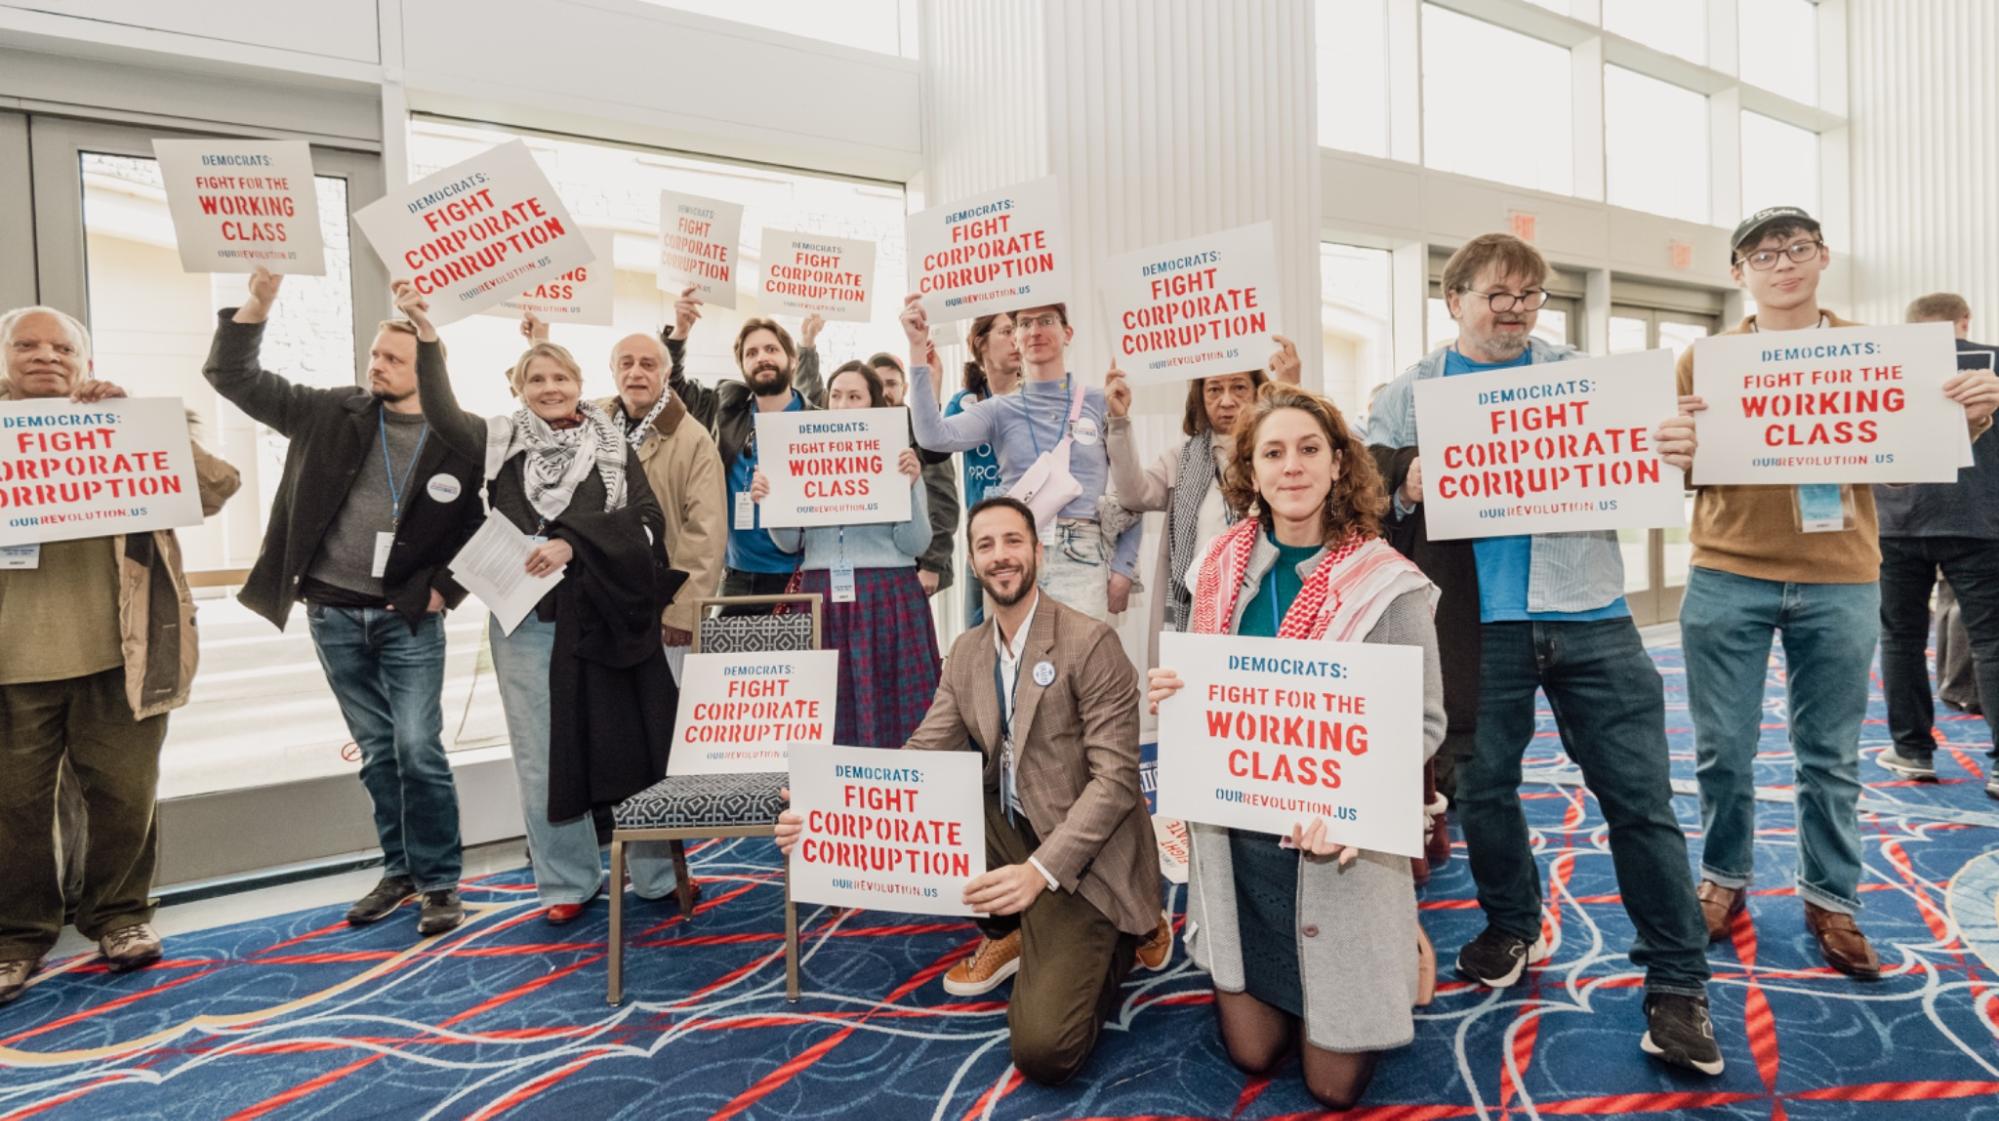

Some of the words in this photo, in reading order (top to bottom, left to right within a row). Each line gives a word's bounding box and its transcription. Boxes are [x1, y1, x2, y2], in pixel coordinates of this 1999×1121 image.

[195, 176, 235, 189] FIGHT
[239, 177, 263, 189] FOR
[265, 177, 289, 190] THE
[408, 172, 490, 213] DEMOCRATS:
[199, 196, 295, 217] WORKING
[423, 188, 496, 232] FIGHT
[945, 199, 1014, 224] DEMOCRATS:
[221, 221, 287, 242] CLASS
[405, 197, 546, 270] CORPORATE
[678, 217, 711, 238] FIGHT
[952, 215, 1010, 243] FIGHT
[414, 217, 566, 295] CORRUPTION
[664, 234, 728, 262] CORPORATE
[795, 252, 841, 269] FIGHT
[924, 230, 1046, 271] CORPORATE
[662, 251, 729, 282] CORRUPTION
[771, 265, 863, 287] CORPORATE
[920, 253, 1054, 294] CORRUPTION
[1142, 250, 1222, 276] DEMOCRATS:
[765, 280, 865, 302] CORRUPTION
[945, 285, 1031, 307] OURREVOLUTION.US
[1151, 268, 1217, 300] FIGHT
[1122, 287, 1257, 330] CORPORATE
[1122, 312, 1266, 355] CORRUPTION
[1762, 342, 1881, 363] DEMOCRATS:
[1743, 371, 1804, 389] FIGHT
[1811, 369, 1853, 385] FOR
[1861, 365, 1904, 382] THE
[1478, 379, 1596, 405] DEMOCRATS:
[1741, 387, 1905, 418] WORKING
[3, 413, 122, 428] DEMOCRATS:
[799, 422, 868, 434] DEMOCRATS:
[1490, 400, 1589, 435] FIGHT
[17, 428, 116, 453] FIGHT
[1764, 420, 1878, 447] CLASS
[788, 442, 825, 455] FIGHT
[828, 441, 853, 453] FOR
[856, 439, 880, 451] THE
[1444, 427, 1648, 469] CORPORATE
[0, 451, 169, 481] ORPORATE
[788, 455, 883, 476] WORKING
[1752, 453, 1894, 468] OURREVOLUTIONUS
[0, 475, 182, 508] ORRUPTION
[804, 479, 869, 498] CLASS
[1439, 459, 1660, 499] CORRUPTION
[10, 508, 148, 527] OURREVOLUTION.US
[1479, 500, 1618, 519] OURREVOLUTION.US
[724, 664, 795, 676] DEMOCRATS:
[1228, 655, 1348, 679] DEMOCRATS:
[728, 679, 789, 698] FIGHT
[1208, 684, 1269, 705] FIGHT
[1275, 689, 1316, 710] FOR
[1322, 692, 1366, 715] THE
[694, 699, 820, 721] CORPORATE
[685, 723, 822, 744] CORRUPTION
[1206, 710, 1369, 756] WORKING
[835, 765, 924, 783] DEMOCRATS:
[1228, 749, 1342, 789] CLASS
[844, 785, 918, 813] FIGHT
[1215, 788, 1357, 821] OURREVOLUTION.US
[809, 810, 962, 846] CORPORATE
[802, 838, 969, 877] CORRUPTION
[832, 877, 938, 898] OURREVOLUTION.US
